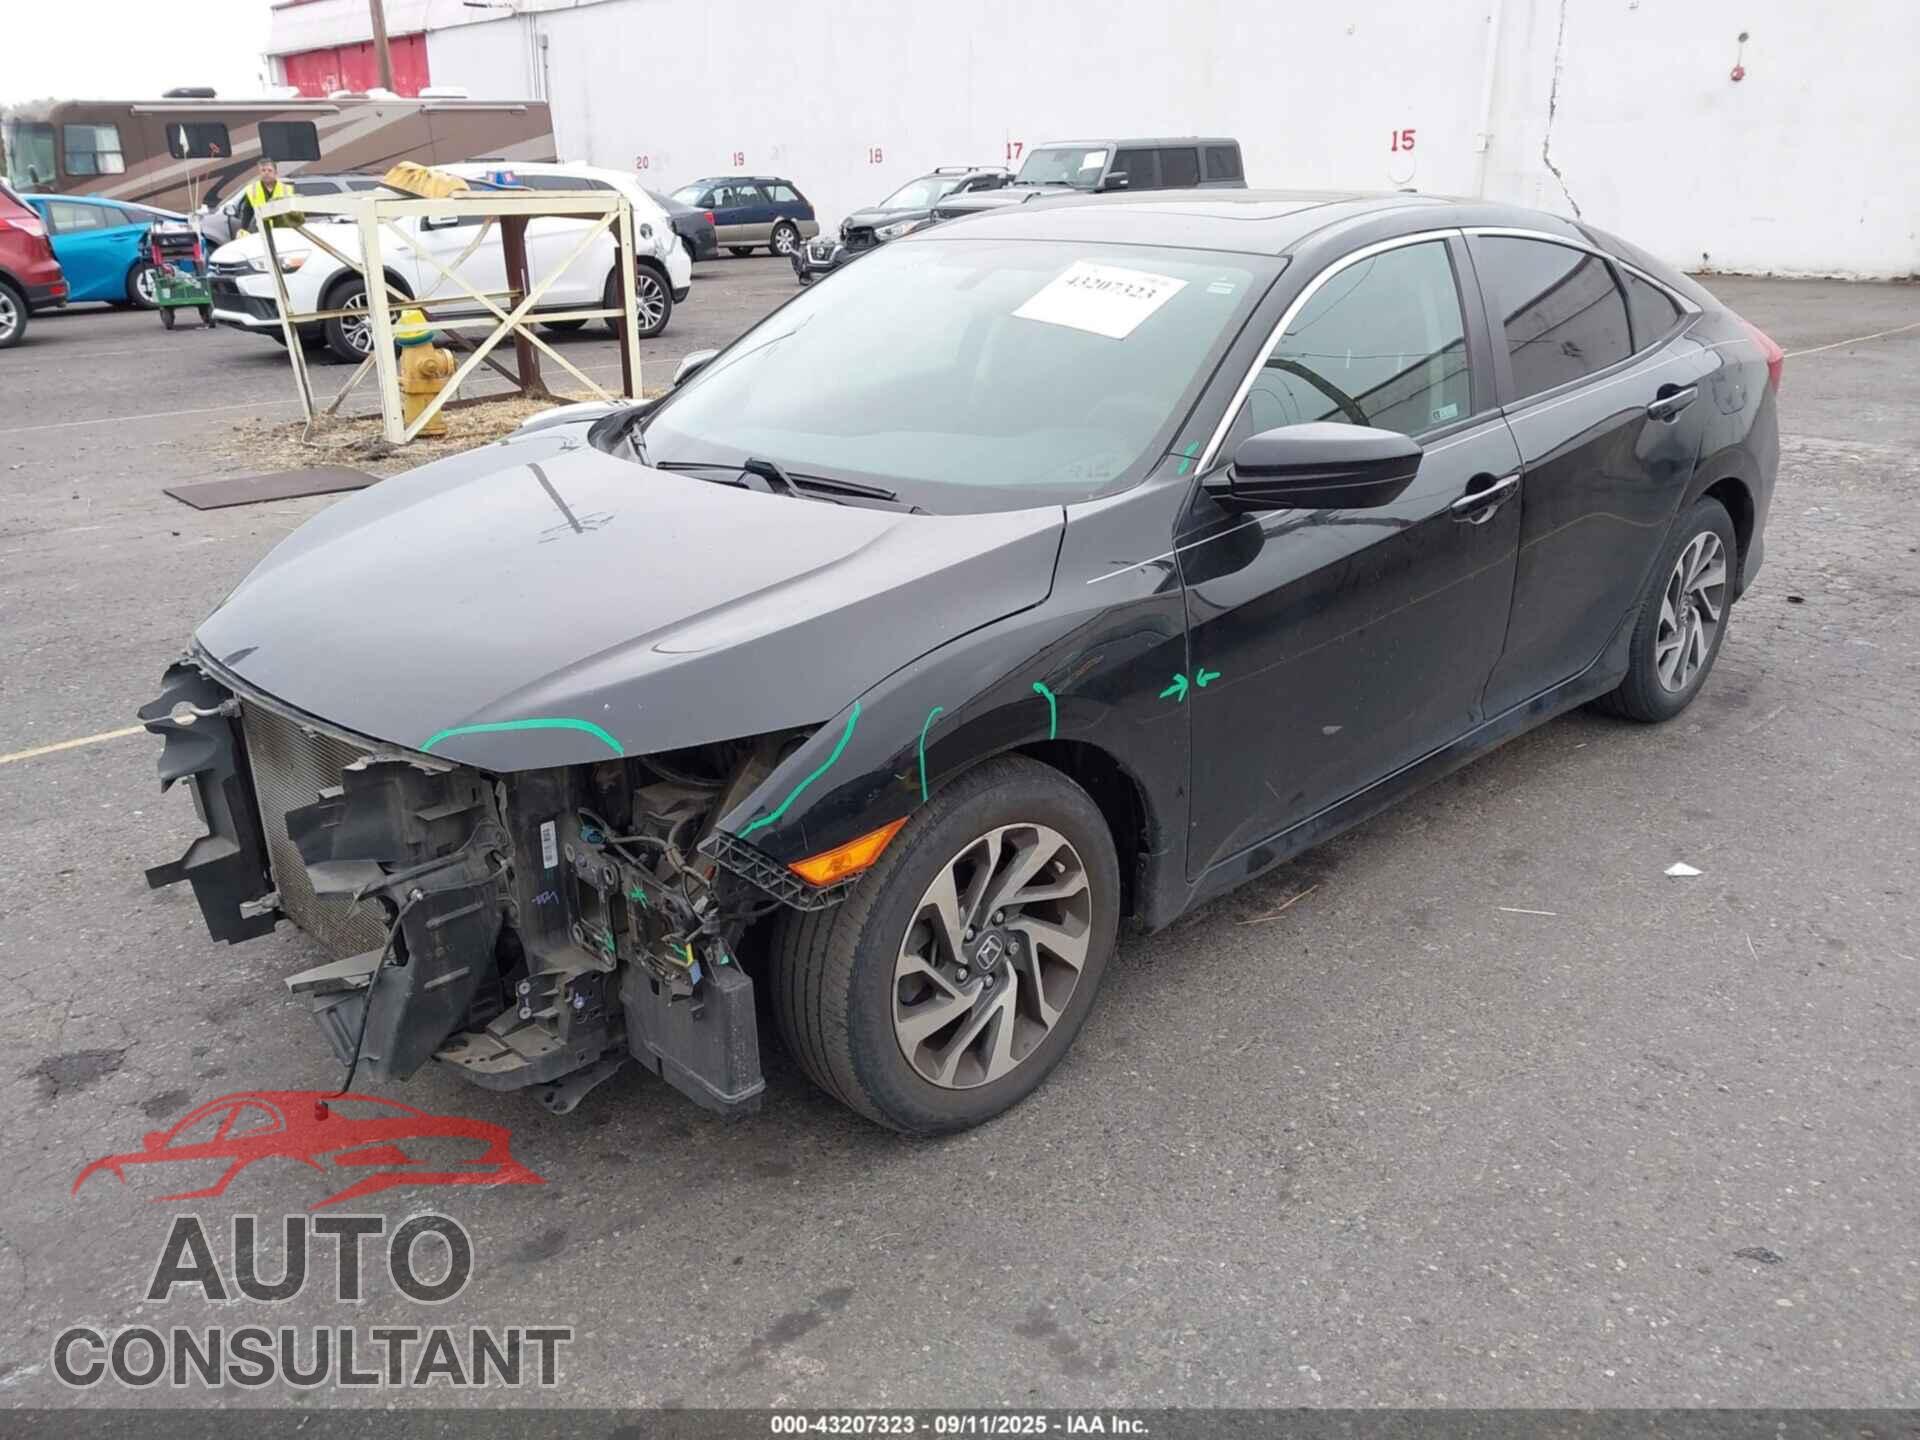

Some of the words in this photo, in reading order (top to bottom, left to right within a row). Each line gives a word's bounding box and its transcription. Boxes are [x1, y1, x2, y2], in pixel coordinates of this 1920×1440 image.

[1391, 129, 1416, 152] 15
[733, 151, 745, 167] 19
[868, 147, 883, 164] 18
[1006, 142, 1023, 160] 17
[636, 155, 649, 169] 20
[1065, 275, 1157, 300] 43207323
